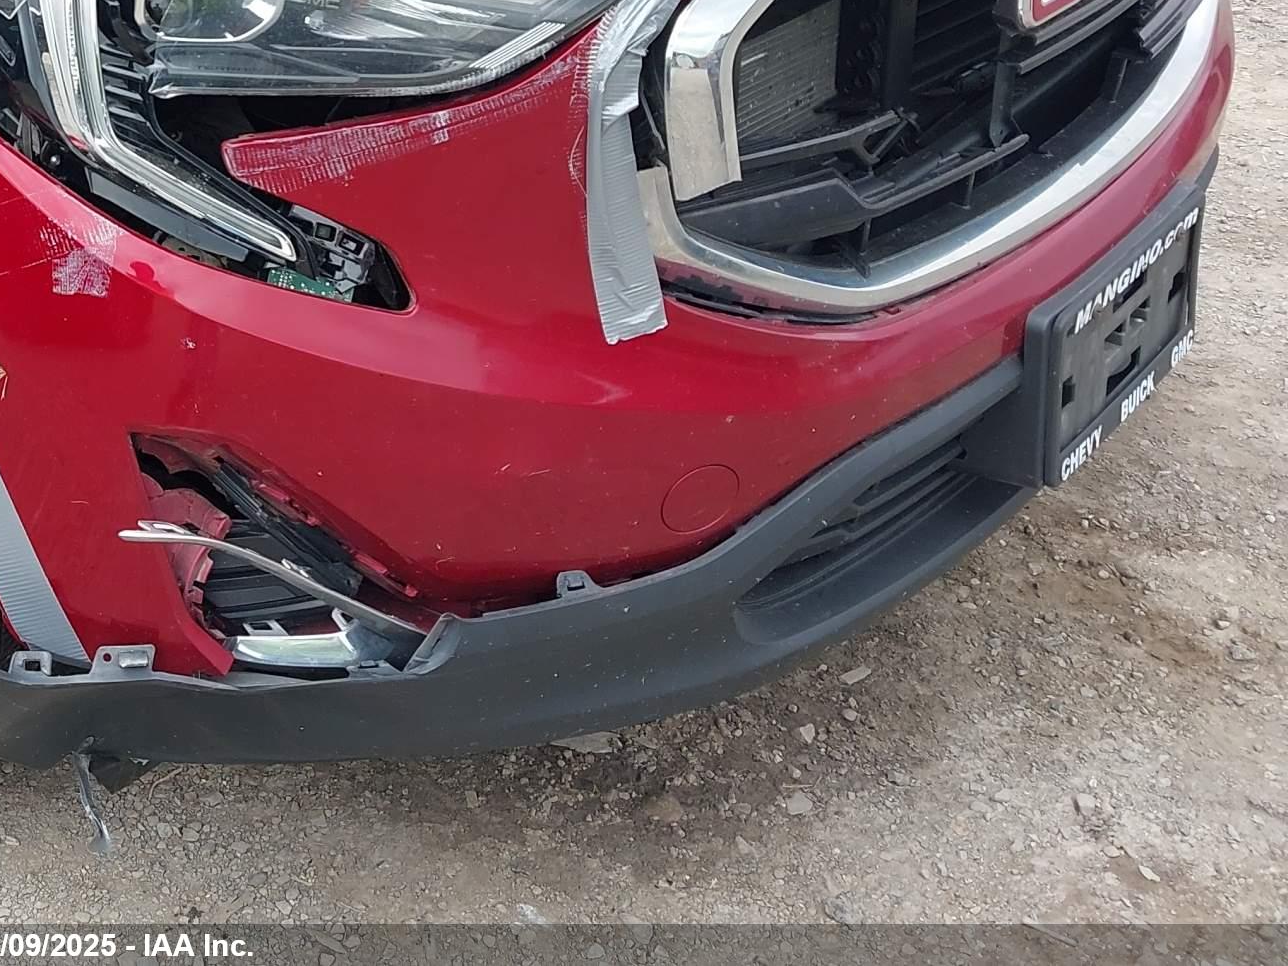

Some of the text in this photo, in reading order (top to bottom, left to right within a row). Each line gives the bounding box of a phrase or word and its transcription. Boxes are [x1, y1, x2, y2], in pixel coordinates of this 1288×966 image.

[1061, 328, 1195, 482] CHEVY BUICK GMC
